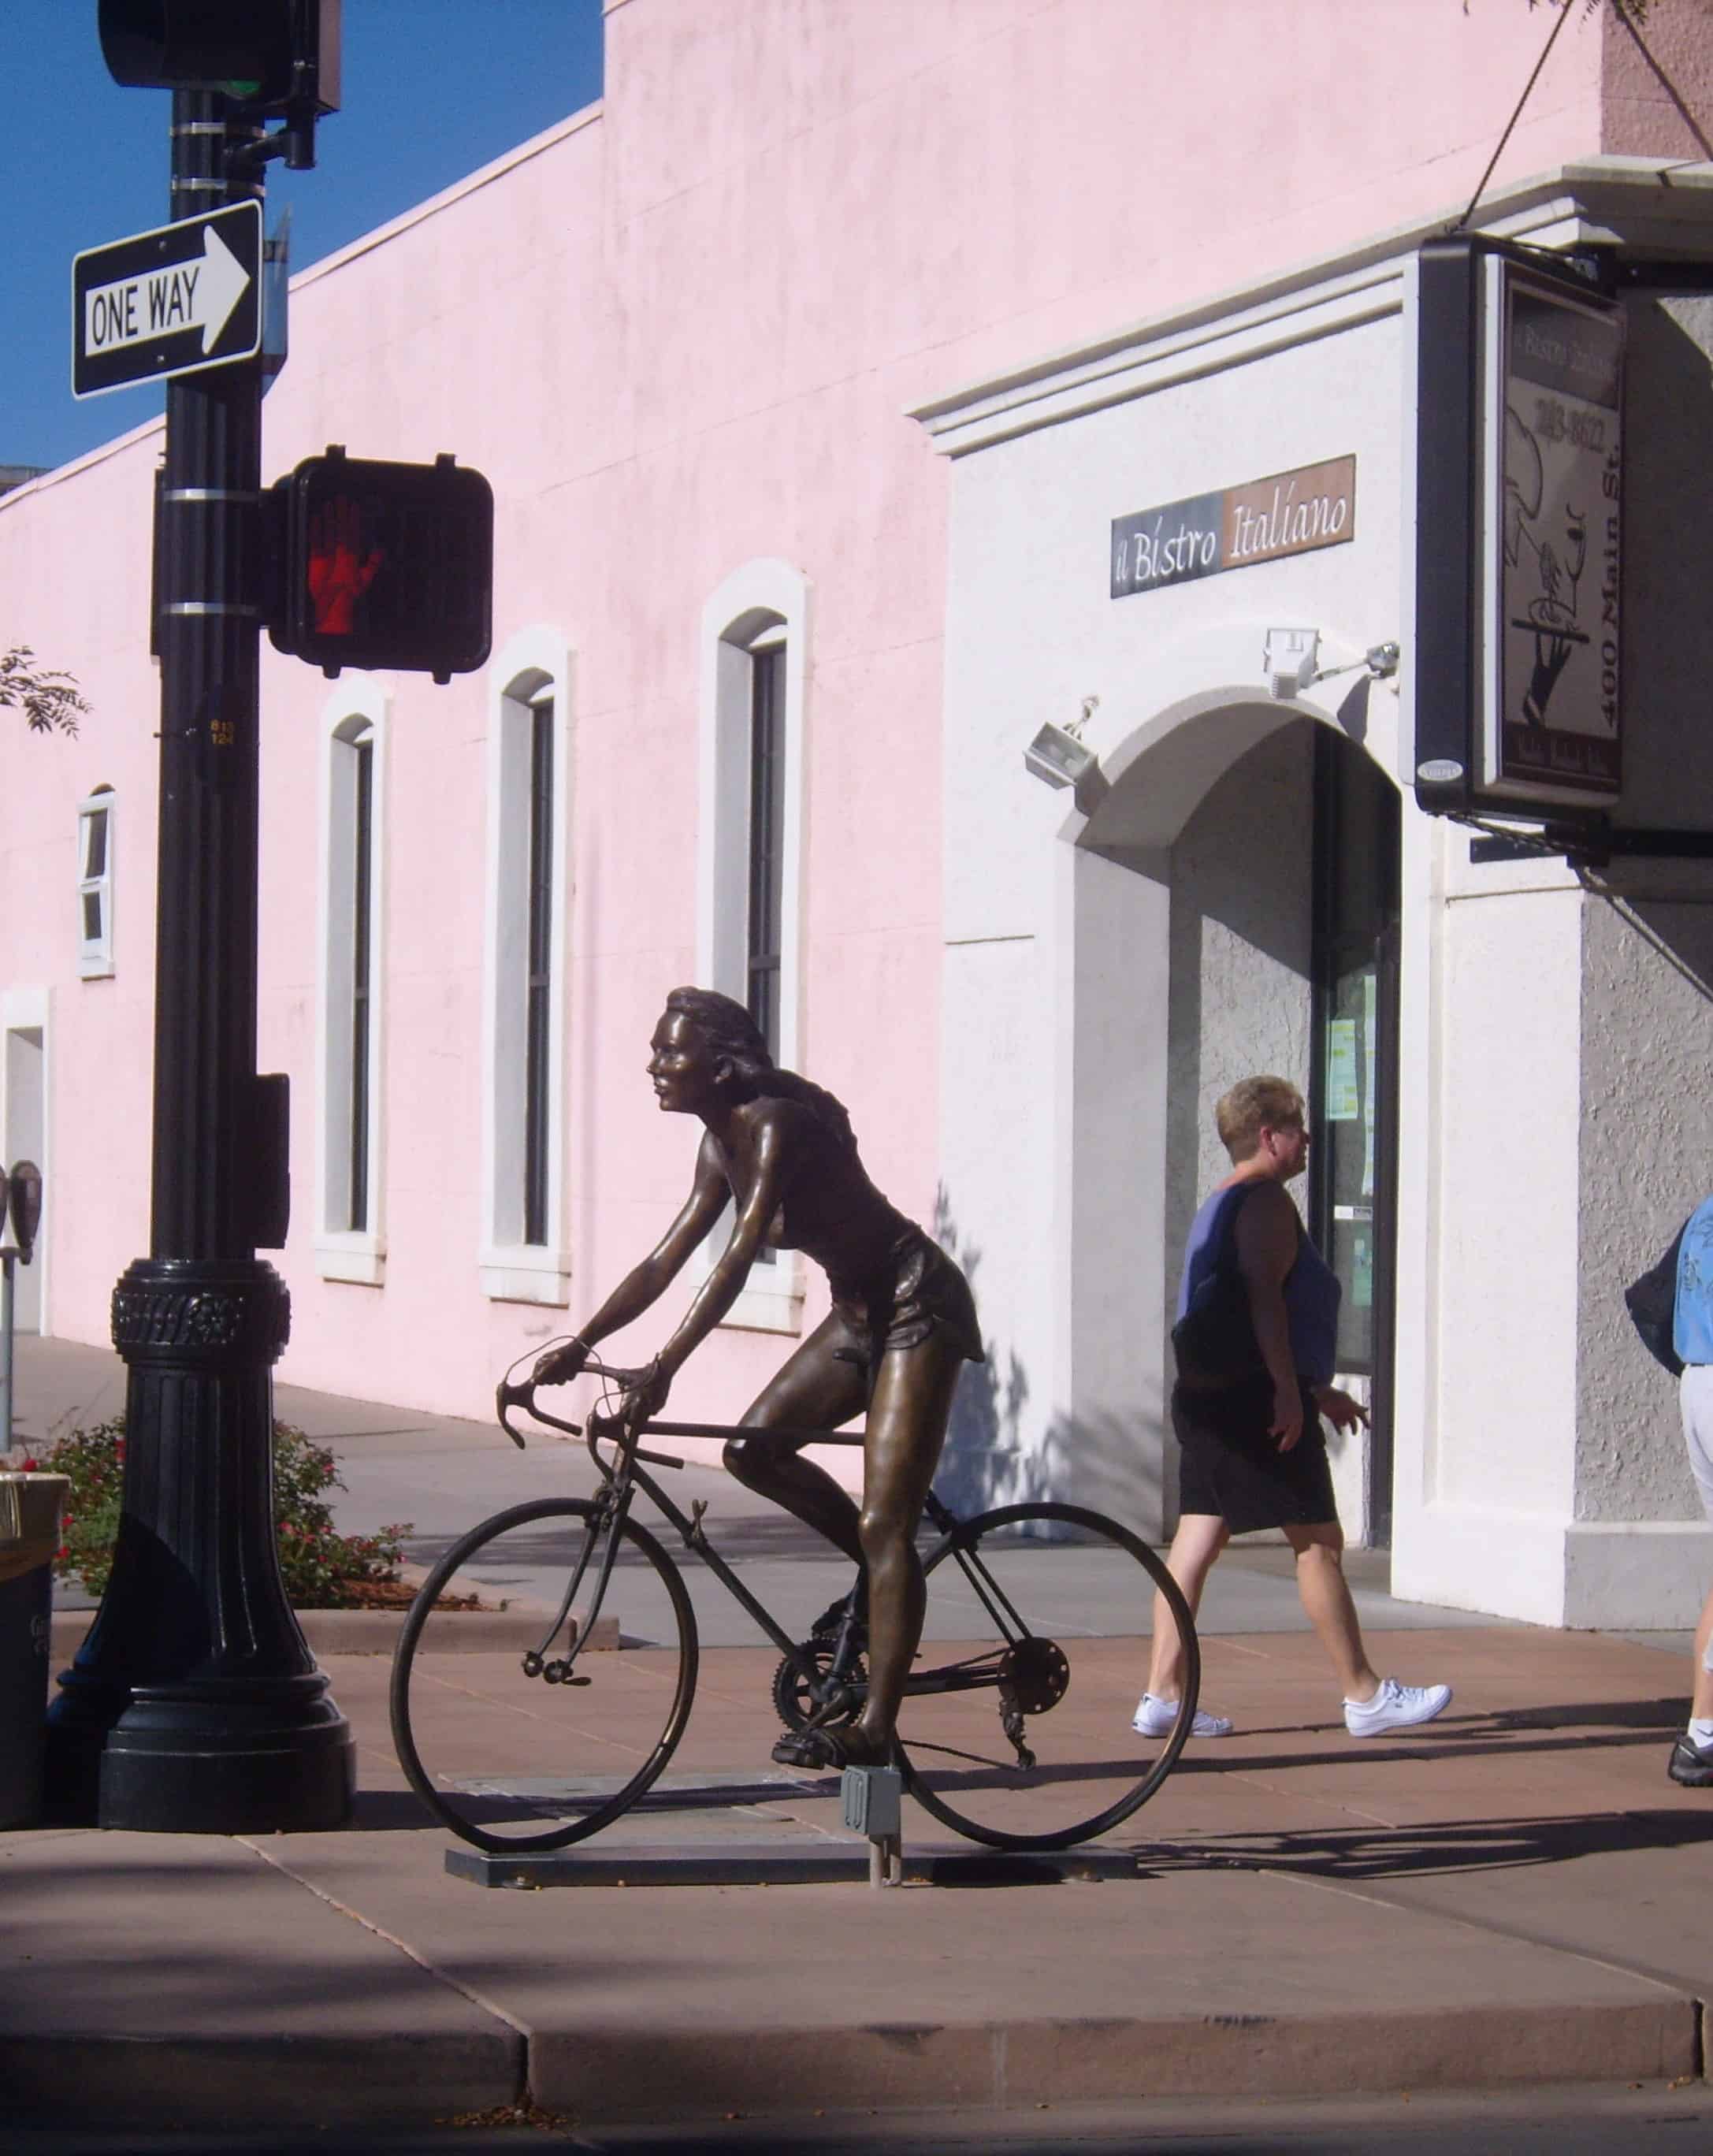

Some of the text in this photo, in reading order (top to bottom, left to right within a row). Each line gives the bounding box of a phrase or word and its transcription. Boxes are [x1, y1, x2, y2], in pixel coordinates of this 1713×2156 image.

[92, 266, 199, 346] ONE WAY
[1601, 517, 1618, 624] Main
[1601, 639, 1616, 728] 400
